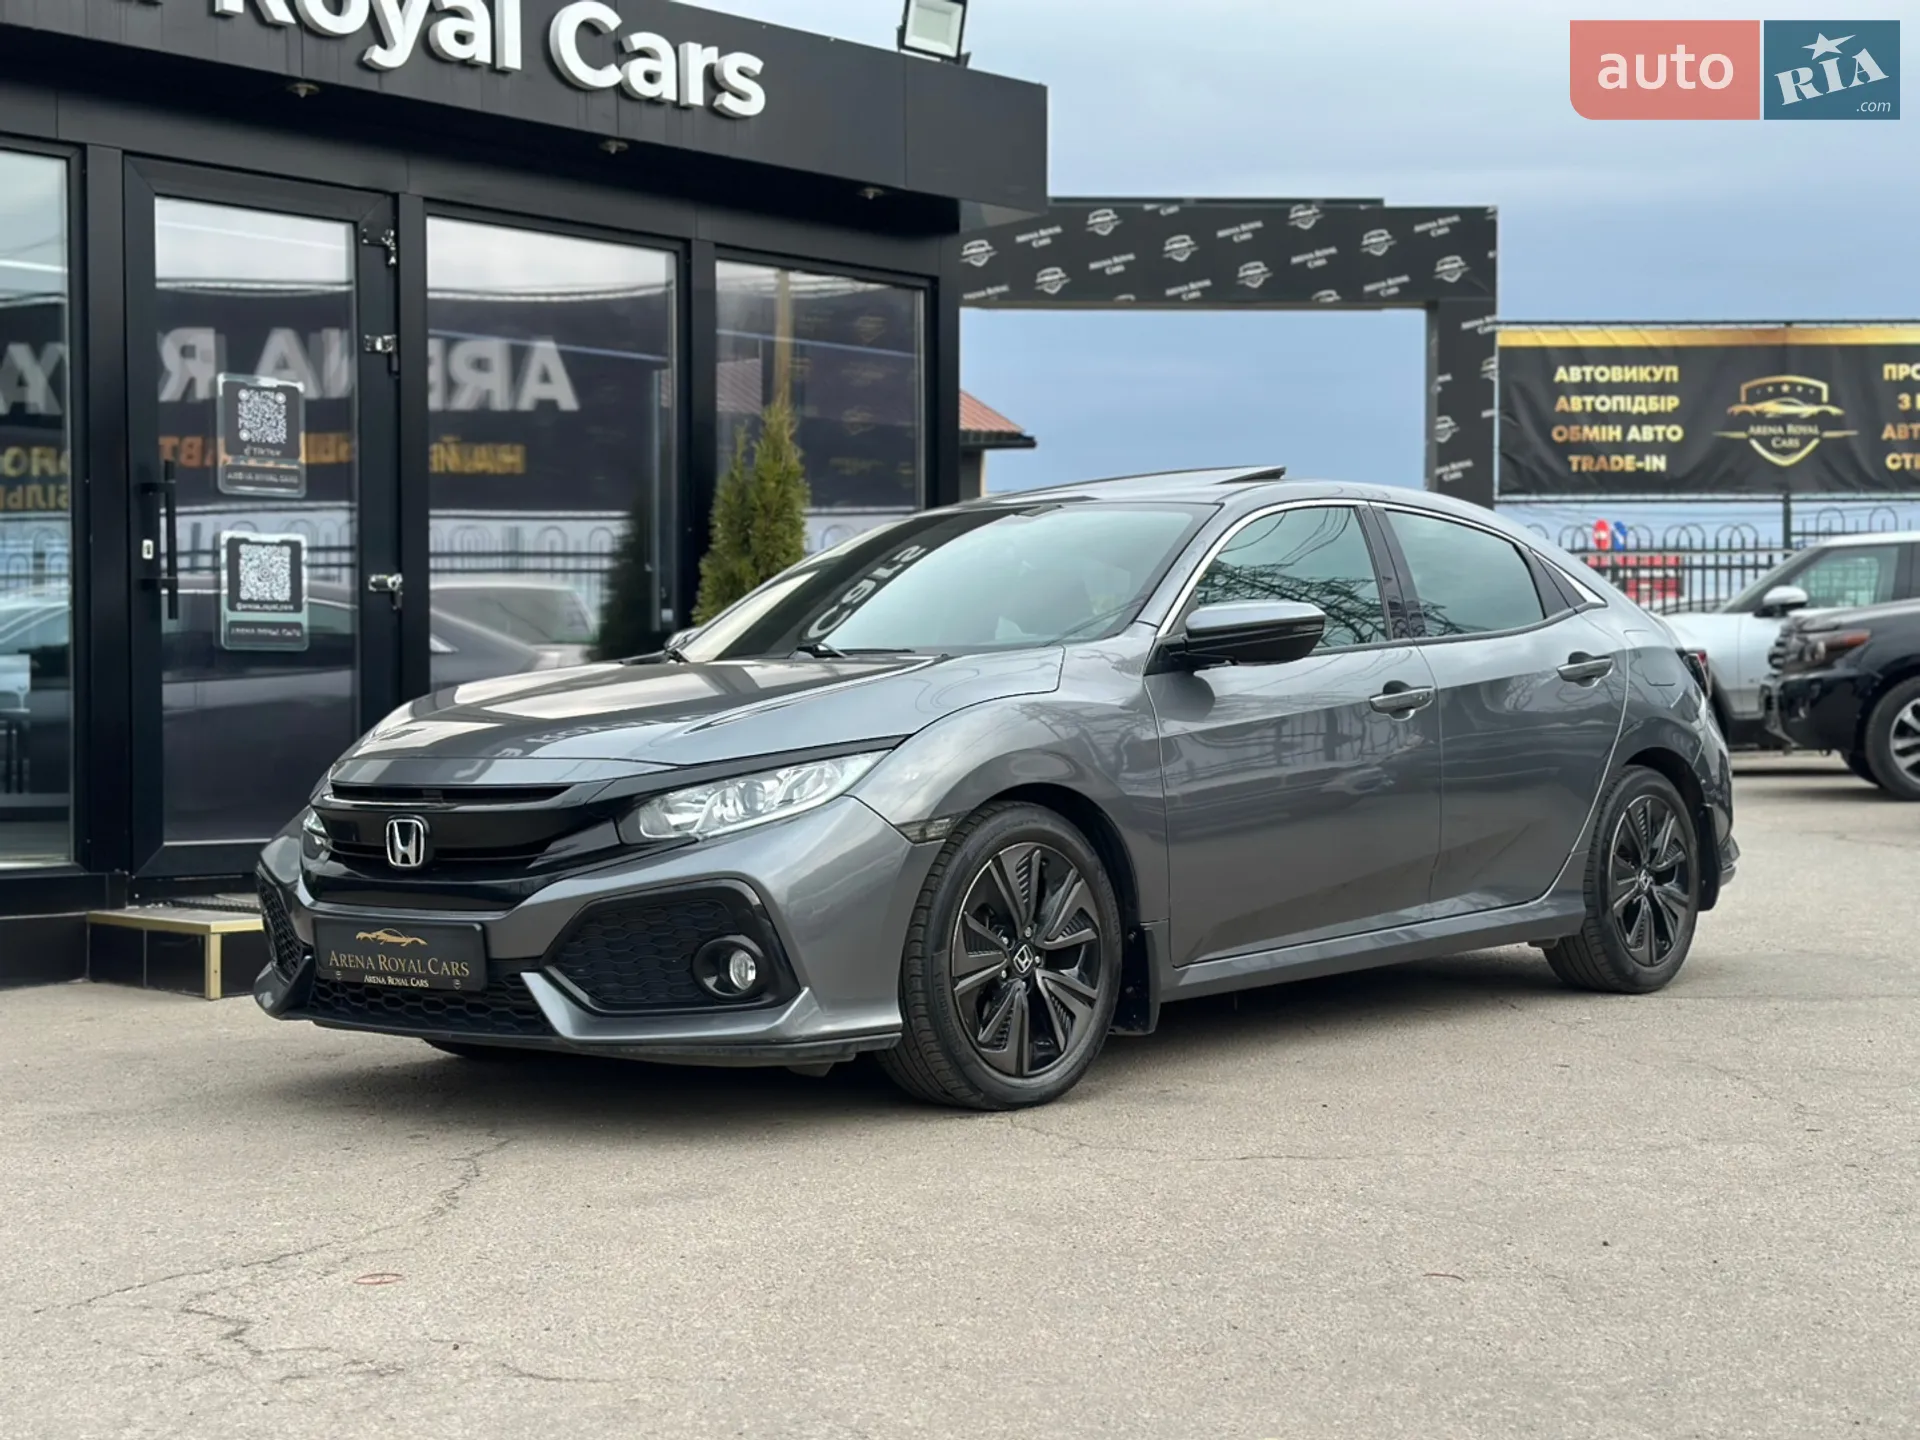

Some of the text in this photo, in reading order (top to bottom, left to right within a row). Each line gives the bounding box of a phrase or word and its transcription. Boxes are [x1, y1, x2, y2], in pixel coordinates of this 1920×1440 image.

[213, 0, 767, 119] oyal Cars
[1553, 365, 1680, 382] АВТОВИКУП
[1554, 395, 1681, 414] АВТОПІДБІР
[1550, 424, 1684, 443] ОБМІН АВТО
[1567, 455, 1667, 472] TRADE-IN
[329, 950, 470, 977] ARENA ROYAL CARS
[364, 974, 387, 985] ARENA
[410, 977, 430, 988] CARS
